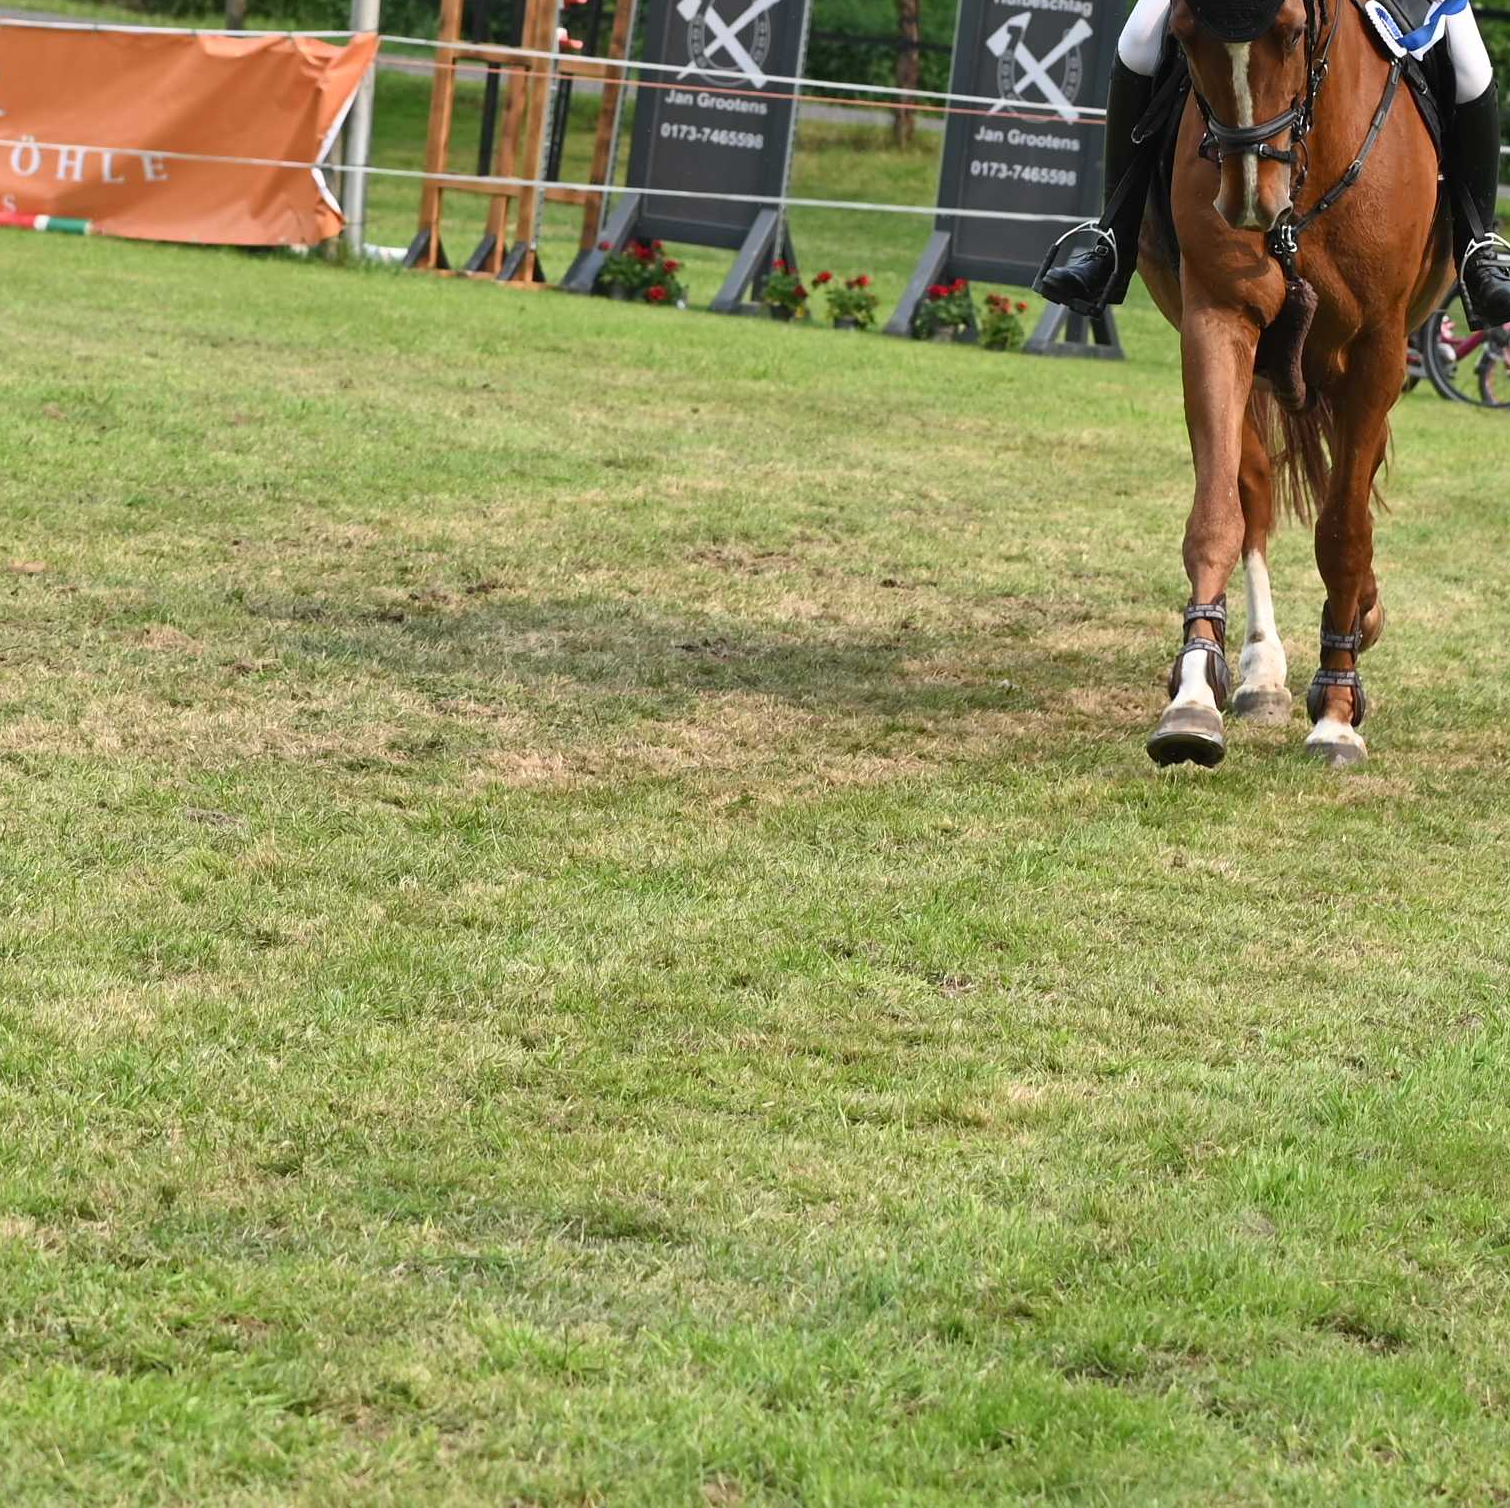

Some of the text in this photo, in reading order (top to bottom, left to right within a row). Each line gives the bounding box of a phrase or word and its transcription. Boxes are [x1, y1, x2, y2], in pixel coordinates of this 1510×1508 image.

[664, 90, 768, 115] Jan Grootens
[975, 126, 1081, 152] Jan Grootens
